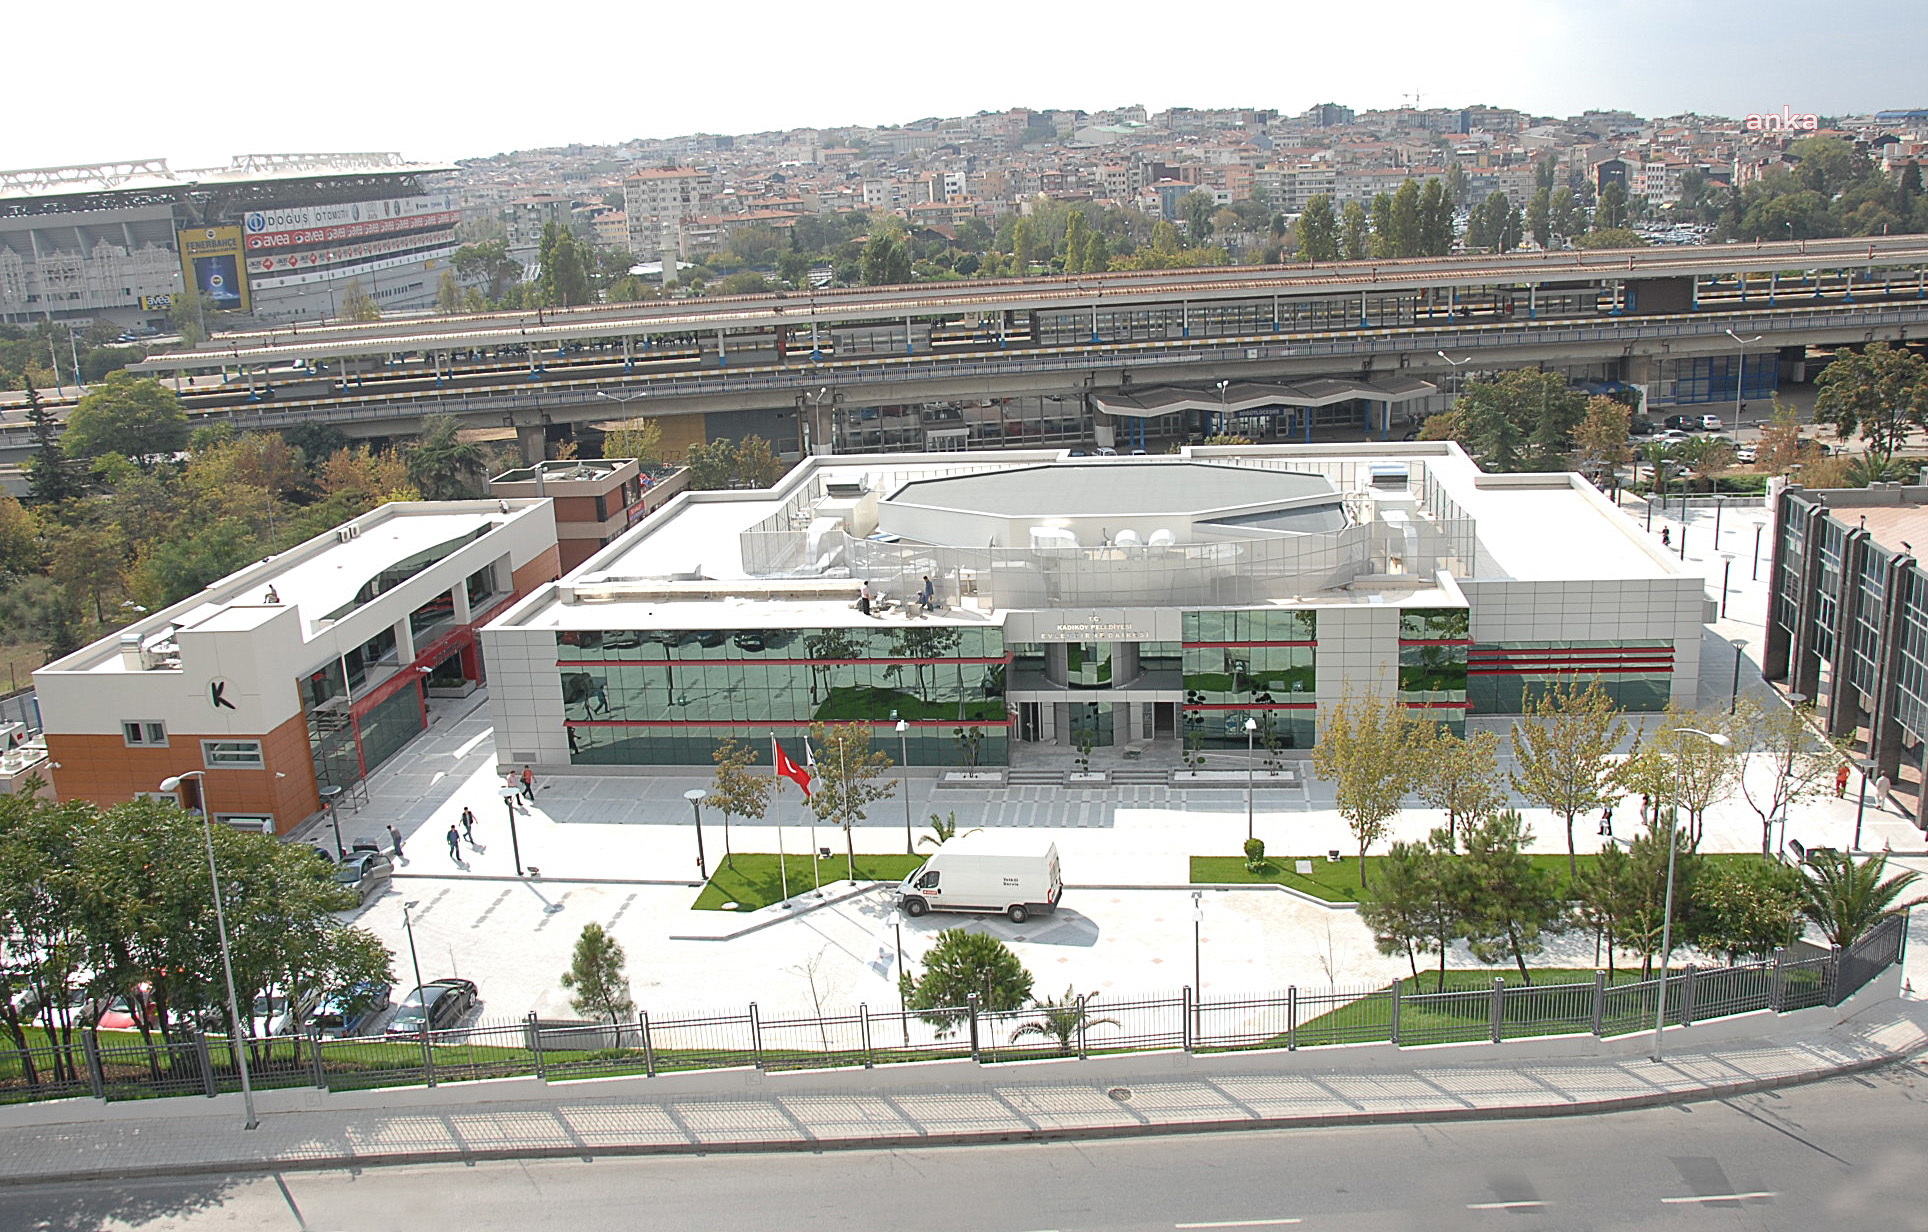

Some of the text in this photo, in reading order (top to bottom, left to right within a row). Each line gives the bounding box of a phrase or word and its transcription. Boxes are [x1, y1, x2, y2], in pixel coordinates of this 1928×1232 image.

[263, 233, 290, 247] avea
[305, 230, 324, 242] avea
[147, 295, 171, 306] avea
[211, 681, 236, 710] K
